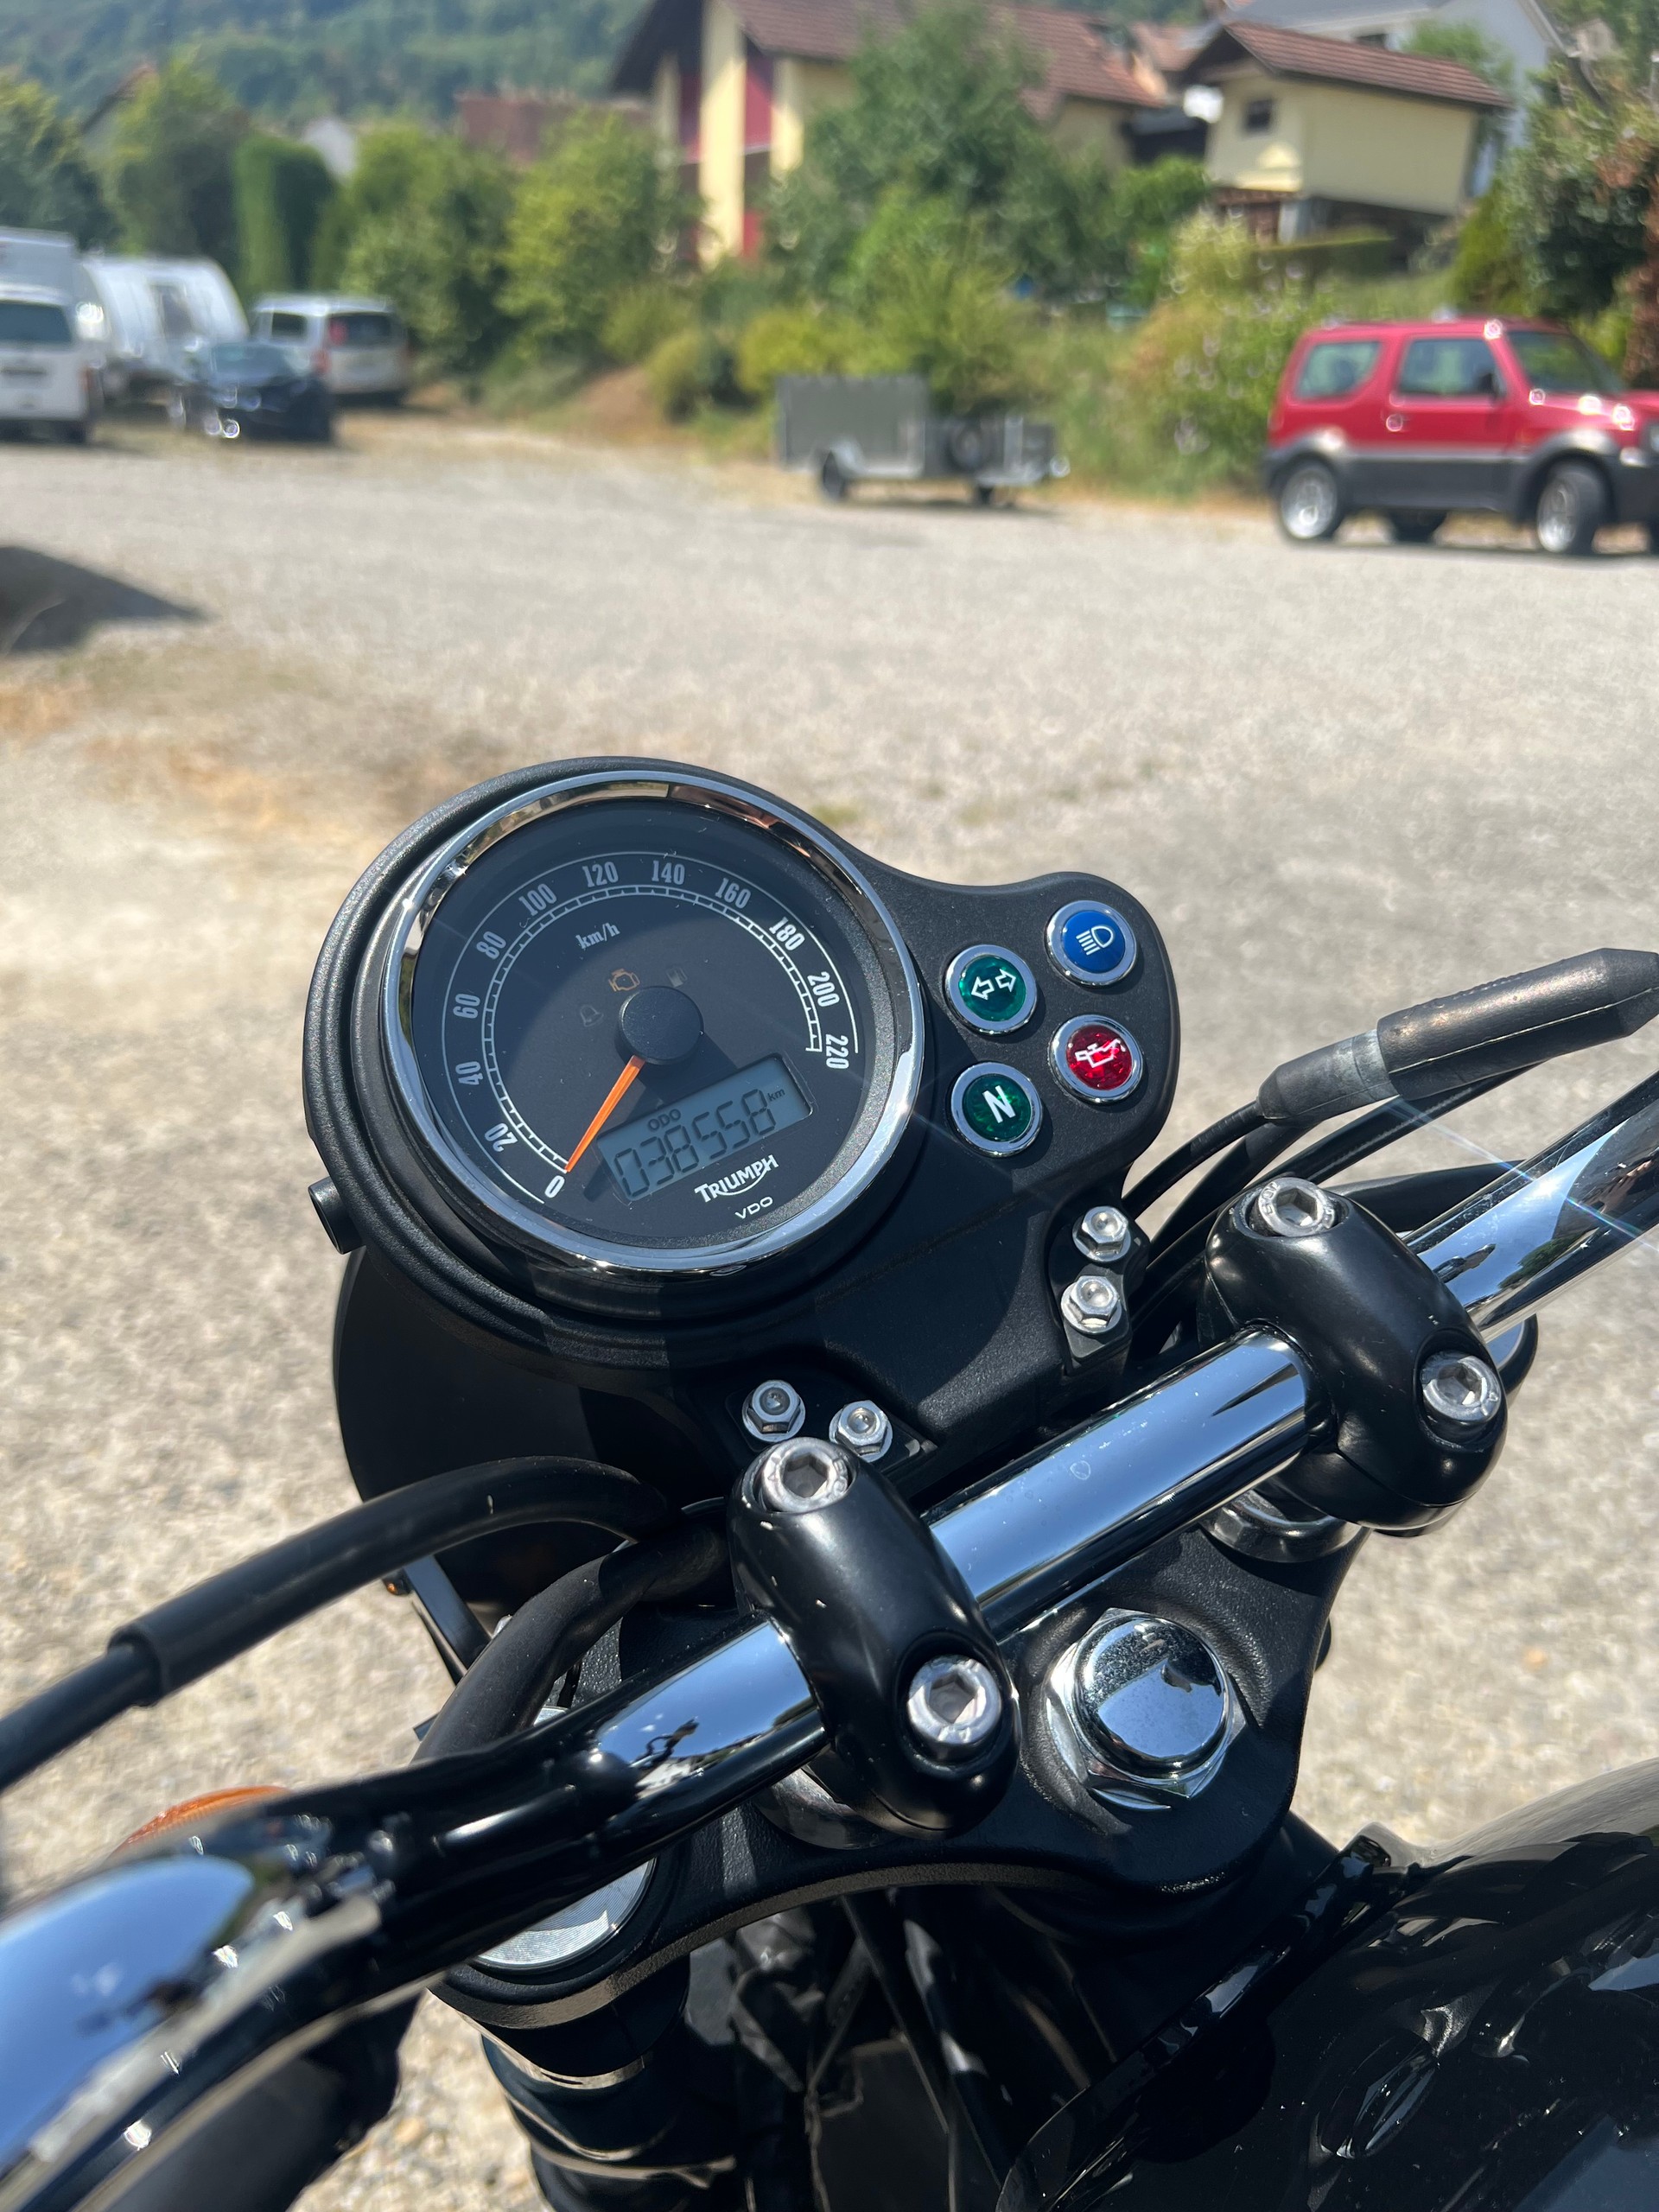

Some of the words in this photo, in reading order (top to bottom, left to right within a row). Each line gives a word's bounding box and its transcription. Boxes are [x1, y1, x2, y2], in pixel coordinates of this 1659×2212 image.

[582, 861, 619, 887] 120
[651, 861, 685, 885] 140
[518, 884, 557, 916] 100
[715, 877, 752, 909] 160
[475, 931, 506, 960] 80
[575, 923, 620, 950] km/h
[768, 917, 805, 951] 180
[806, 971, 840, 1007] 200
[452, 993, 481, 1019] 60
[825, 1033, 849, 1070] 220
[454, 1061, 484, 1085] 40
[982, 1084, 1016, 1123] N
[648, 1109, 682, 1131] ODO
[485, 1122, 518, 1153] 20
[613, 1089, 777, 1198] 038558
[767, 1088, 785, 1102] km
[544, 1175, 565, 1198] 0
[694, 1154, 779, 1203] TRIUMPH
[734, 1196, 773, 1219] VDO
